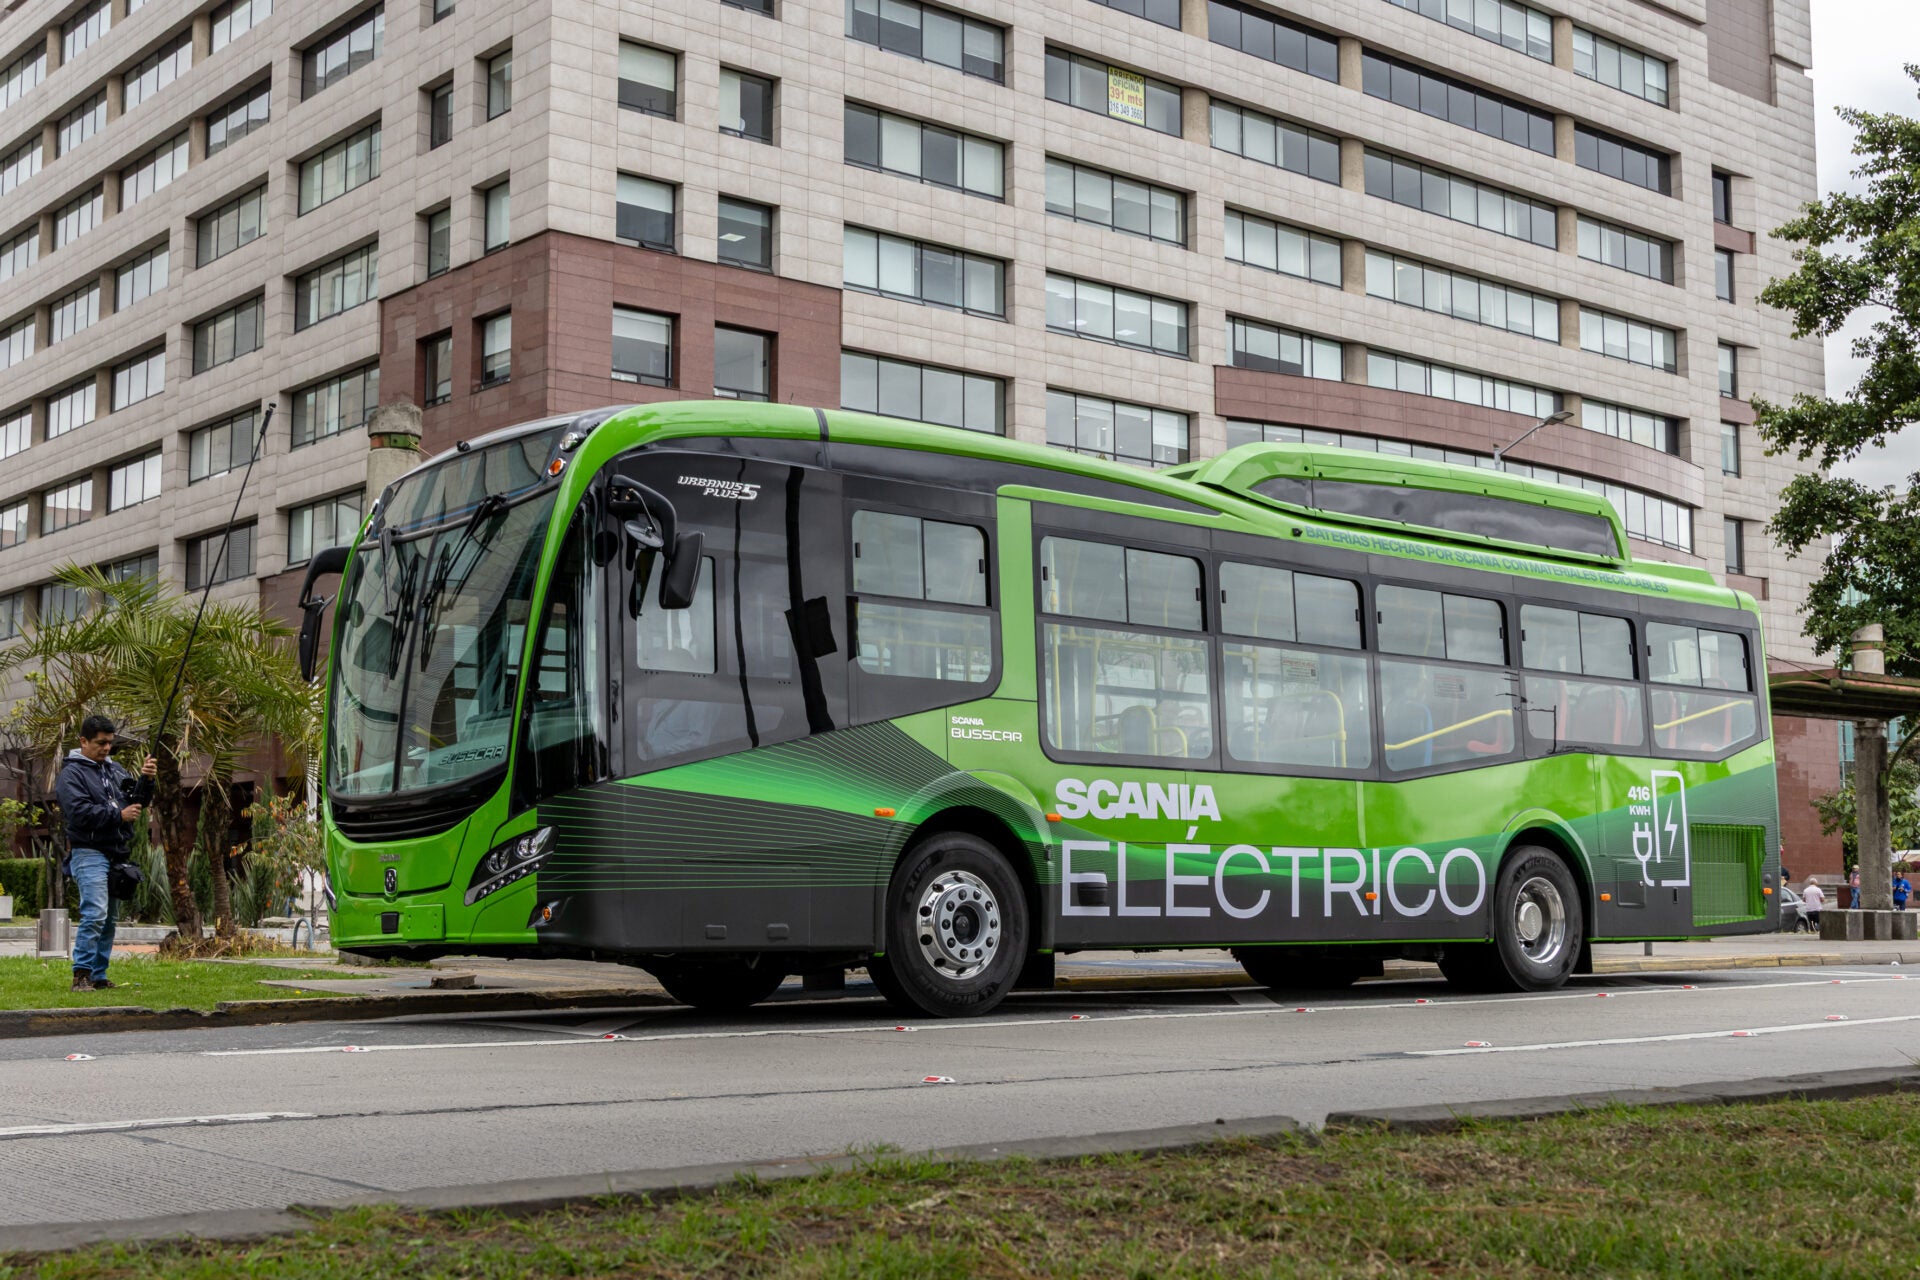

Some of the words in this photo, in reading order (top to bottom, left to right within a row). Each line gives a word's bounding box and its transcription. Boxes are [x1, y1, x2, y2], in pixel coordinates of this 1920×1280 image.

[1112, 78, 1140, 93] OFICINA
[1109, 86, 1125, 102] 391
[1127, 94, 1143, 107] mts
[677, 475, 744, 491] URBANUS
[703, 487, 741, 499] PLUS
[1305, 525, 1370, 547] BATERÍAS
[1372, 537, 1425, 556] HECHAS
[1427, 546, 1454, 561] POR
[1455, 551, 1500, 567] SCANIA
[1502, 557, 1529, 572] CON
[1529, 564, 1598, 580] MATERIALES
[1598, 573, 1669, 593] RECICLABLES
[951, 716, 984, 726] SCANIA
[951, 727, 1022, 742] BUSSCAR
[1055, 778, 1221, 822] SCANIA
[1628, 785, 1650, 801] 416
[1629, 805, 1651, 816] KWH
[1061, 825, 1486, 919] ELÉCTRICO
